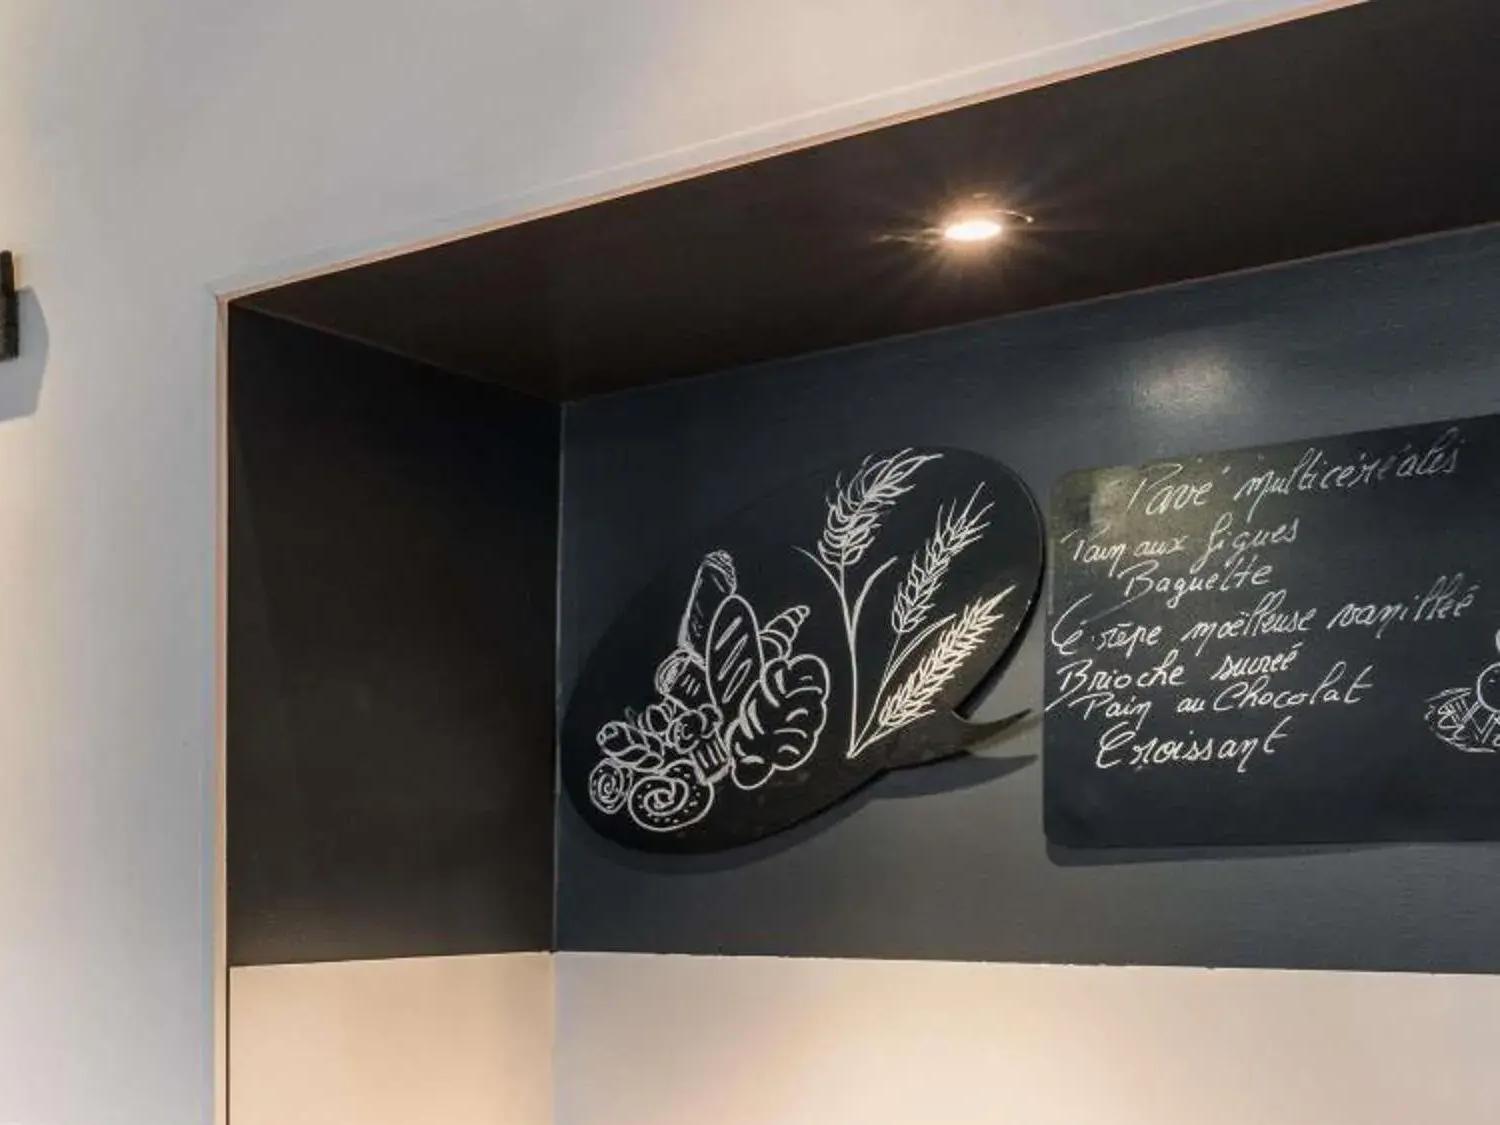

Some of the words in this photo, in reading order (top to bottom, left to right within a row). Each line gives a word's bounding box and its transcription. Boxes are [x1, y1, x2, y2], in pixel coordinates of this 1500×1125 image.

[1134, 534, 1188, 557] aux
[1116, 558, 1273, 609] Baguette
[1055, 648, 1187, 693] Brioche
[1069, 690, 1153, 731] Pain
[1177, 697, 1204, 713] au
[1213, 661, 1374, 711] Chocolat
[1096, 716, 1292, 773] Croissant
